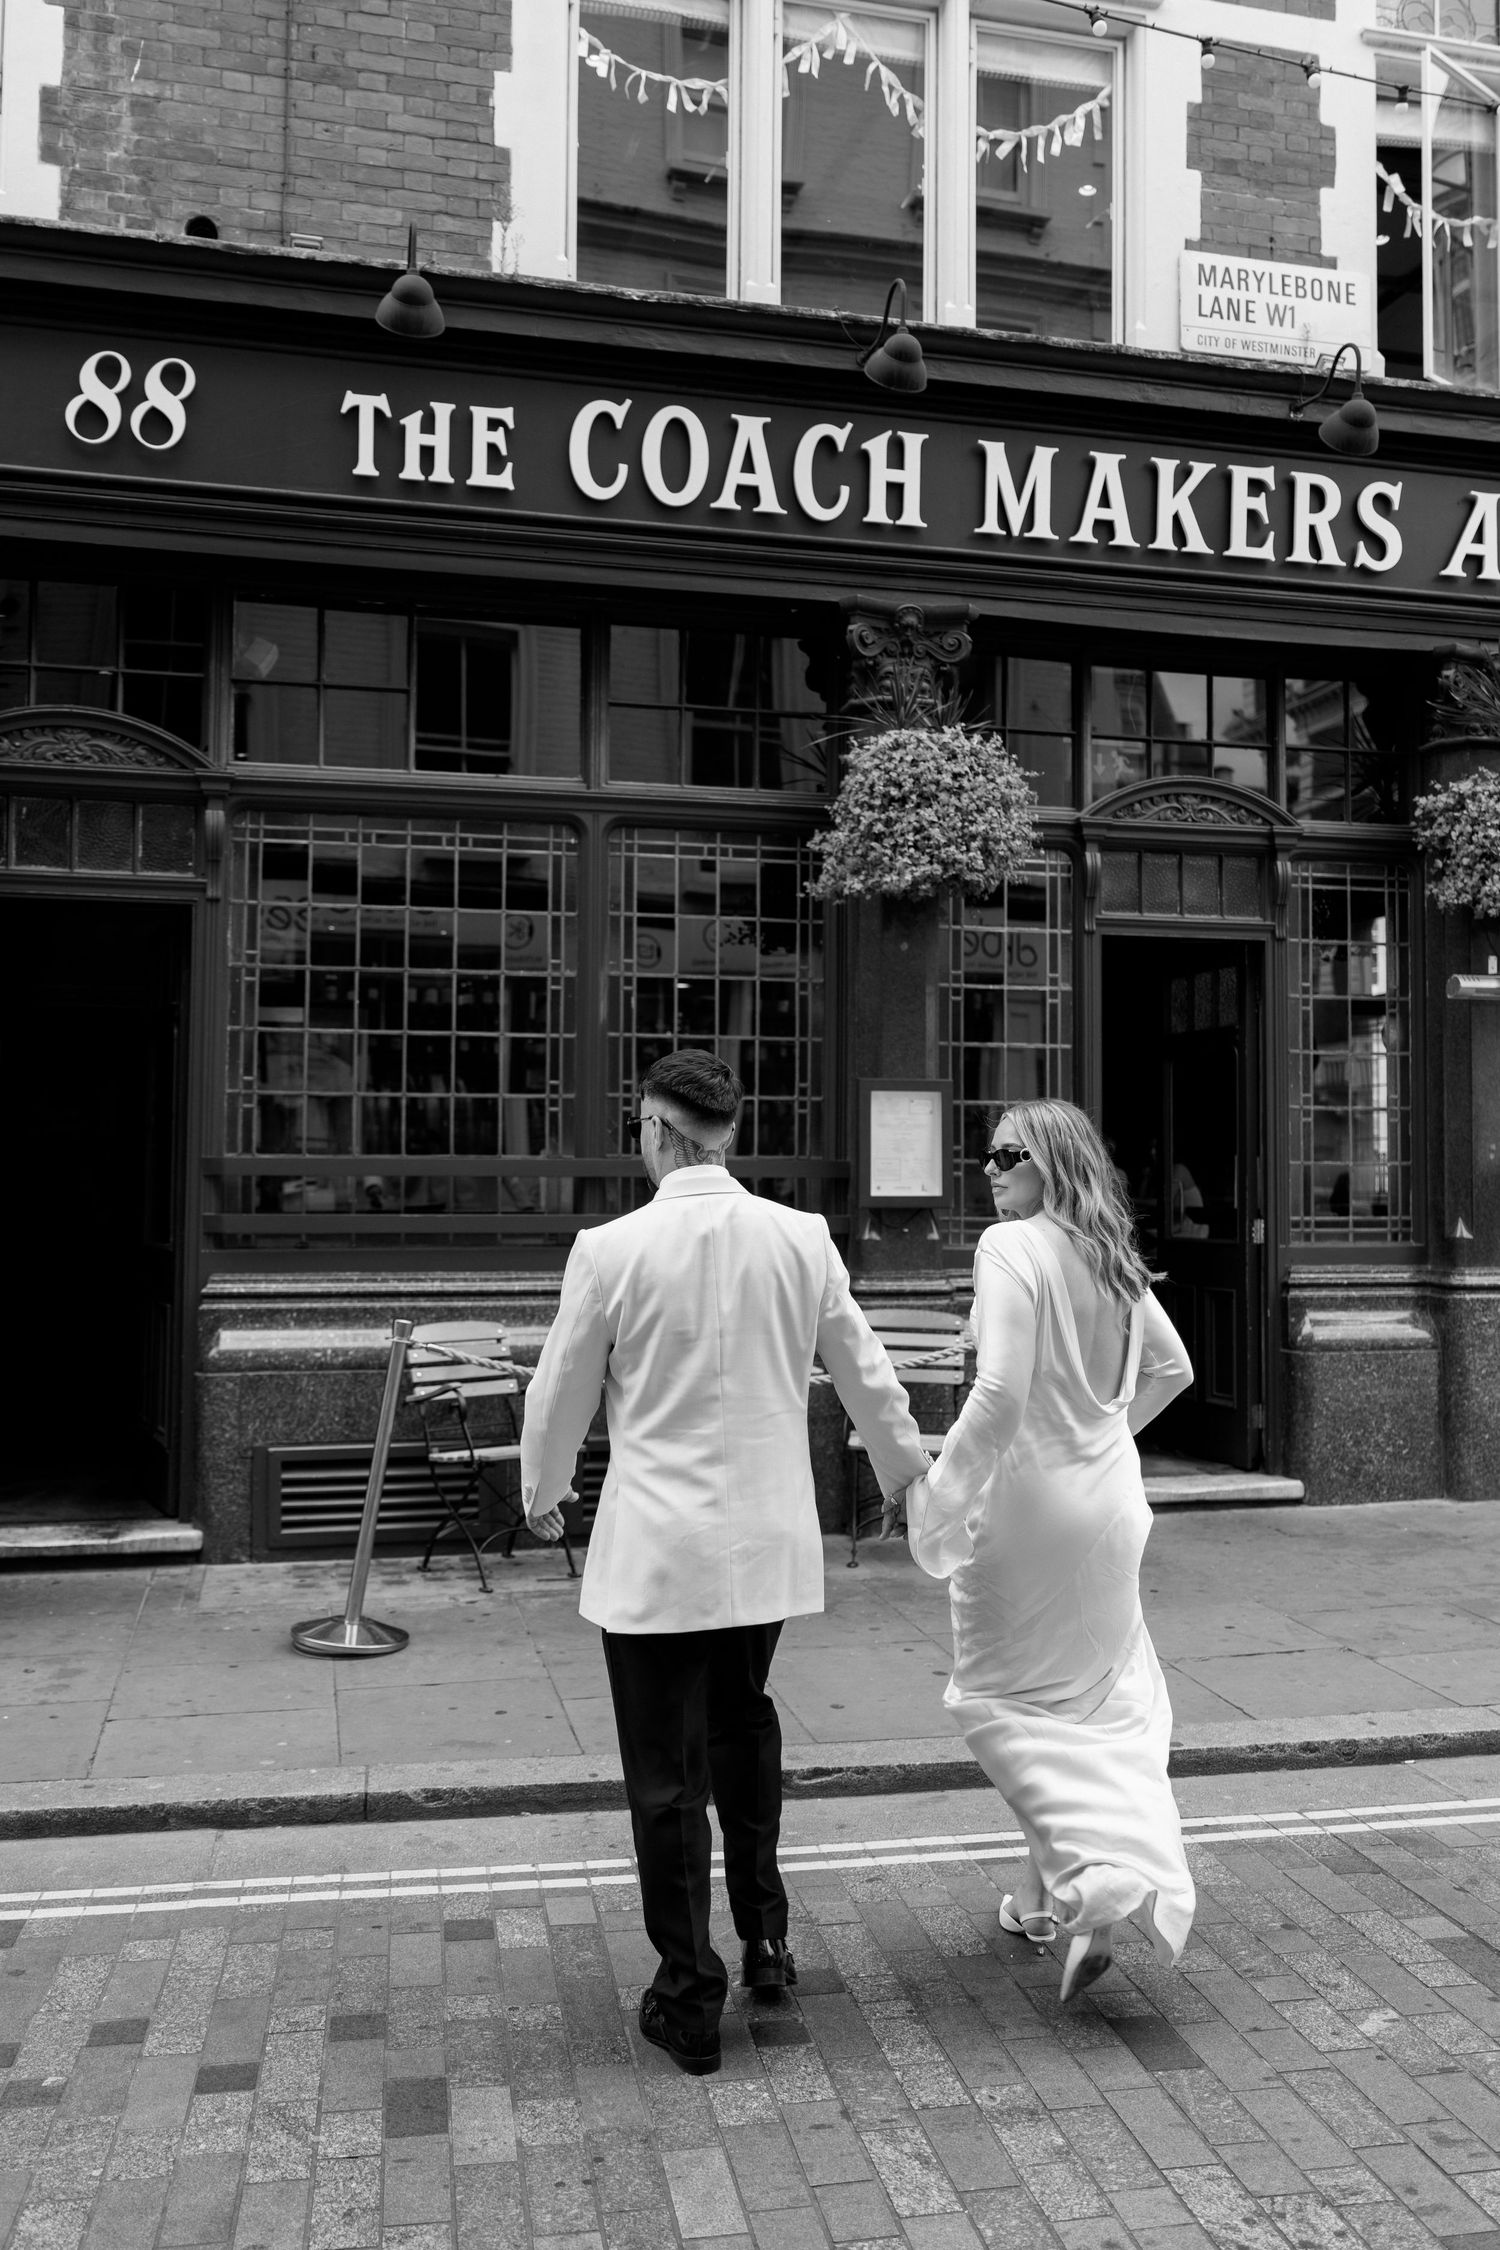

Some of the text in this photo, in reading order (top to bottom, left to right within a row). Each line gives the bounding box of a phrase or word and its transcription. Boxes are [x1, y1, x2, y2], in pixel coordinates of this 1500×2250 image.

[1197, 263, 1357, 306] MARYLEBONE
[1197, 293, 1296, 329] LANE W1
[1197, 334, 1316, 359] CITY OF WESTMINSTER
[65, 350, 196, 450] 88
[341, 389, 516, 491] THE
[569, 398, 930, 528] COACH
[974, 439, 1403, 572] MAKERS
